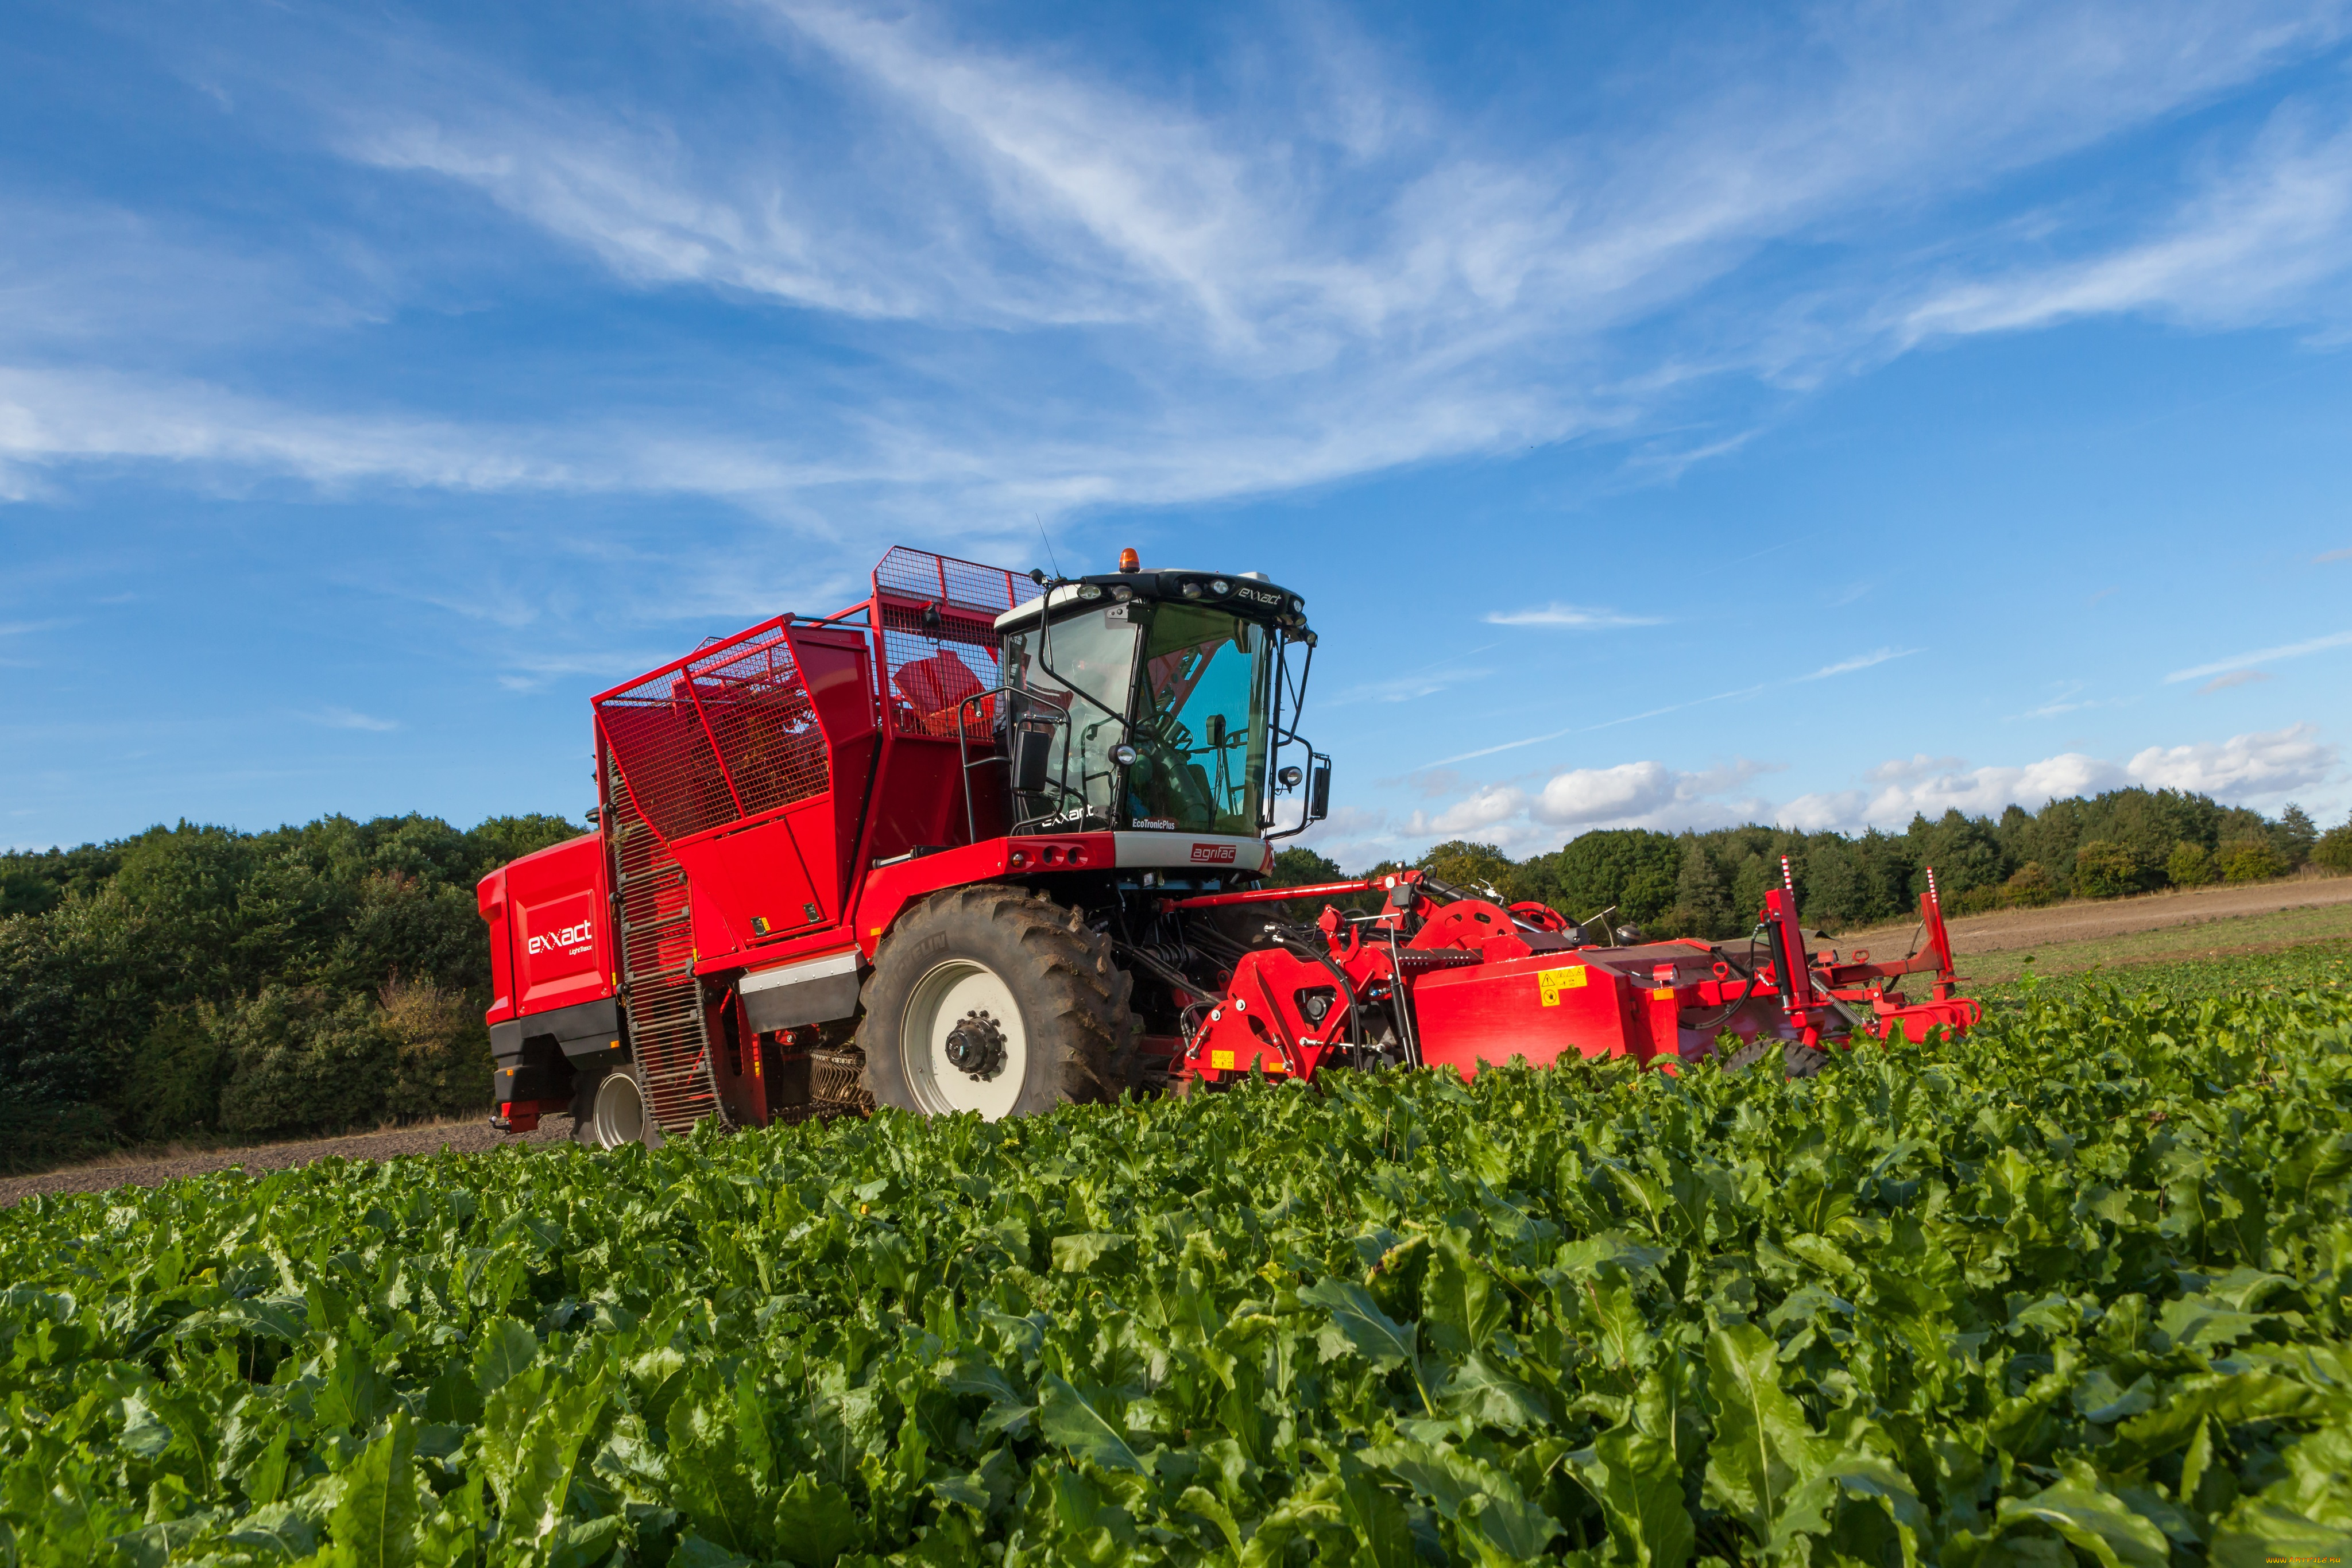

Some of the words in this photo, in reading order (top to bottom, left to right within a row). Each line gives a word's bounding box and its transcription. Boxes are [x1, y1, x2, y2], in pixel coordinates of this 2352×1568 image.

[1239, 588, 1282, 605] exxact
[1132, 818, 1175, 830] EcoTronicPlus
[1190, 847, 1236, 861] agrifac
[528, 920, 592, 954] exxact
[569, 945, 592, 955] LightTraxx
